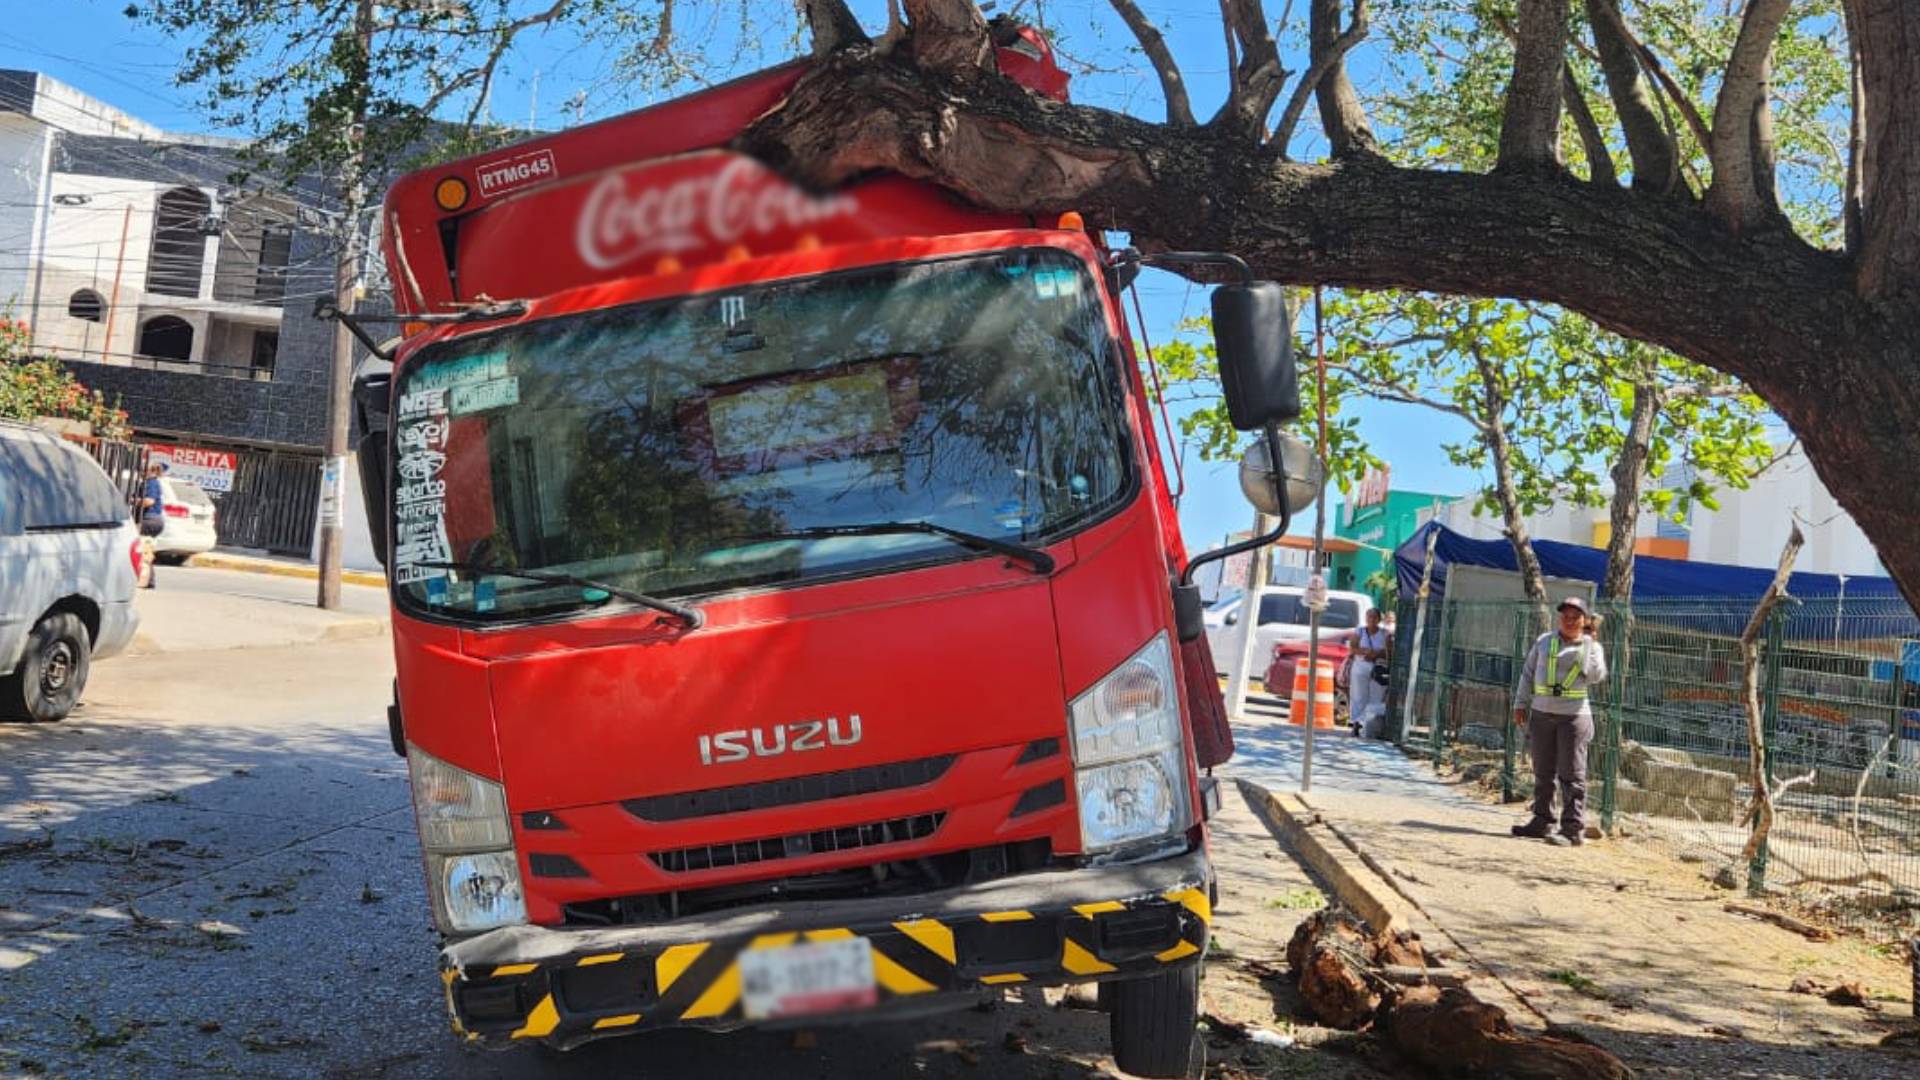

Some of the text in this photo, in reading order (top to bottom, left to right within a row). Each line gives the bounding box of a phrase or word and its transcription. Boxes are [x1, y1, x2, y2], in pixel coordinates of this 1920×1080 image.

[481, 157, 550, 189] RTMG45
[173, 448, 230, 469] RENTA
[699, 714, 862, 766] ISUZU
